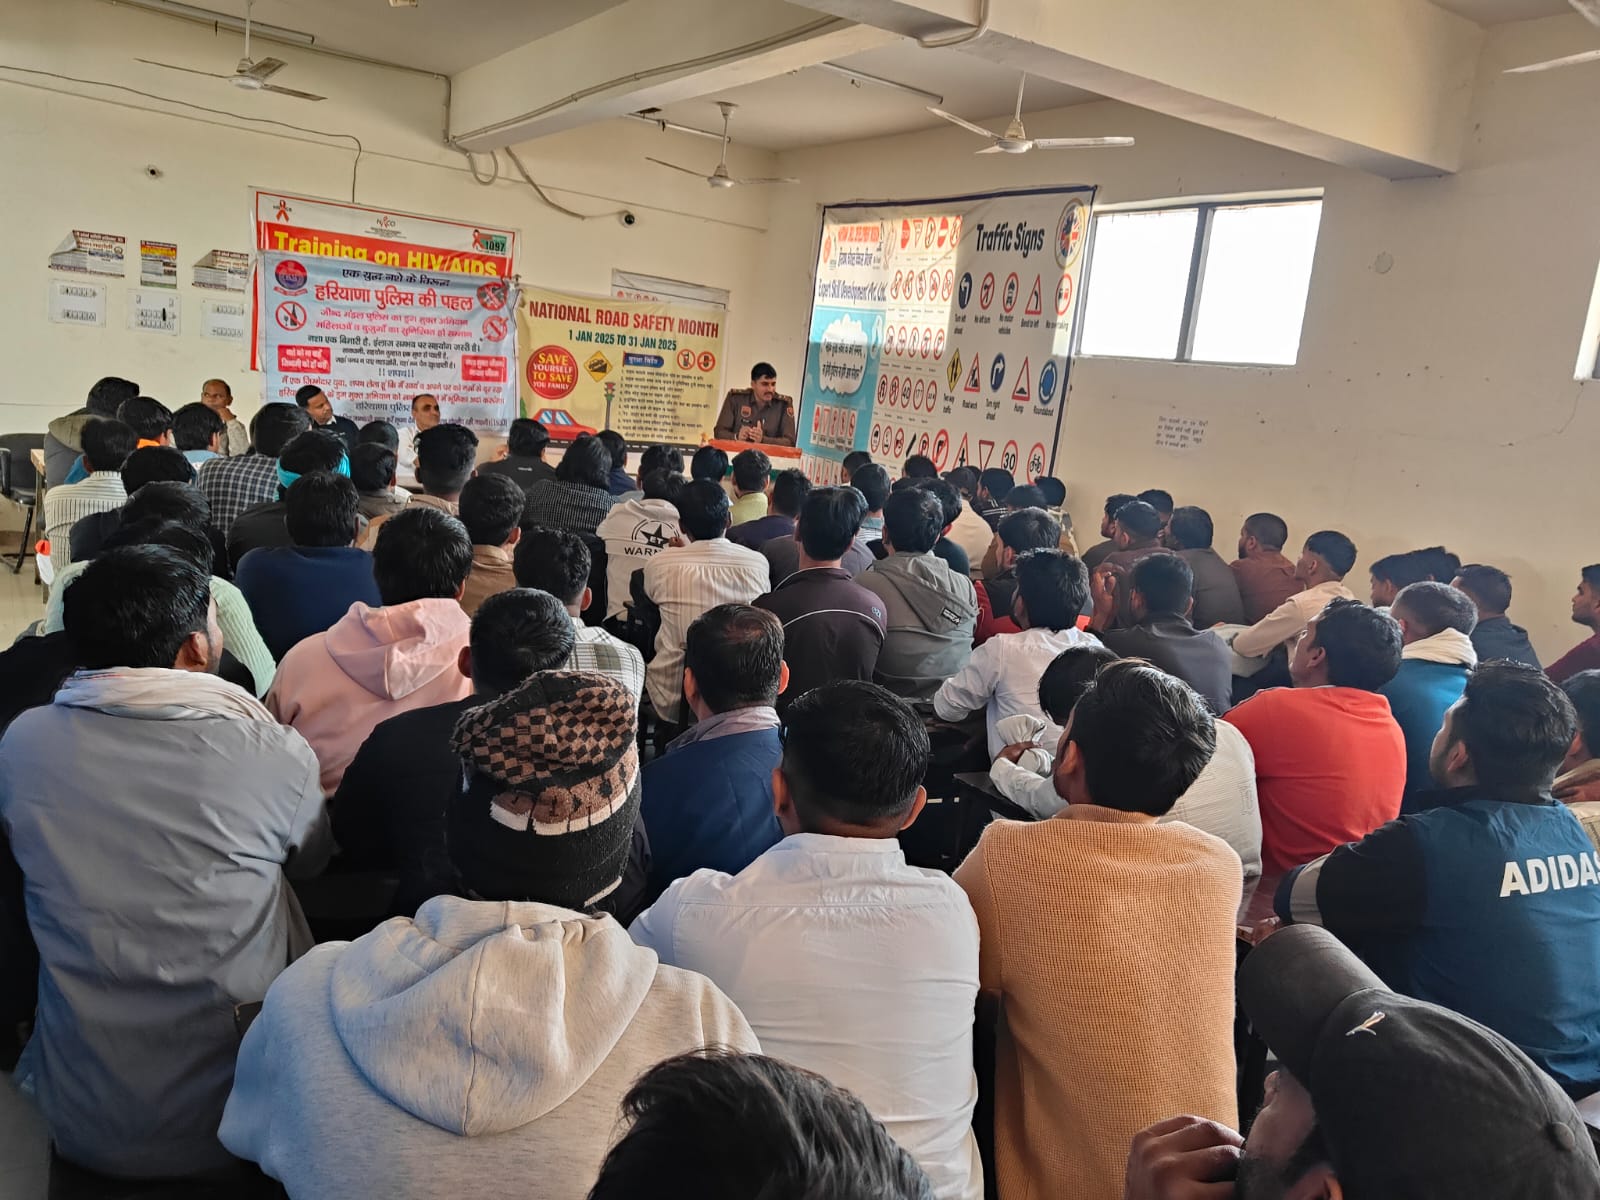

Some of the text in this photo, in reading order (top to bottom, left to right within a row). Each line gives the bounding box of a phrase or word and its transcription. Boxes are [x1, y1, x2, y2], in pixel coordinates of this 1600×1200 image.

[485, 239, 505, 252] 1097
[976, 220, 1045, 259] Traffic Signs
[274, 231, 367, 262] Training
[374, 249, 400, 268] on
[408, 252, 497, 278] HIV/AIDS
[342, 268, 360, 278] एक
[406, 272, 416, 284] के
[314, 280, 474, 312] हरियाणा पुलिस की पहल
[366, 310, 389, 323] पुलिस
[529, 301, 720, 339] NATIONAL ROAD SAFETY MONTH
[324, 336, 337, 344] एक
[569, 330, 677, 351] 1 JAN 2025 TO 31 JAN 2025
[538, 352, 569, 367] SAVE
[532, 362, 573, 374] YOURSELF
[532, 371, 573, 385] TO SAVE
[532, 380, 570, 391] YOU FAMILY
[355, 401, 388, 411] हरियाणा
[1003, 452, 1016, 471] 30
[650, 536, 664, 545] ET
